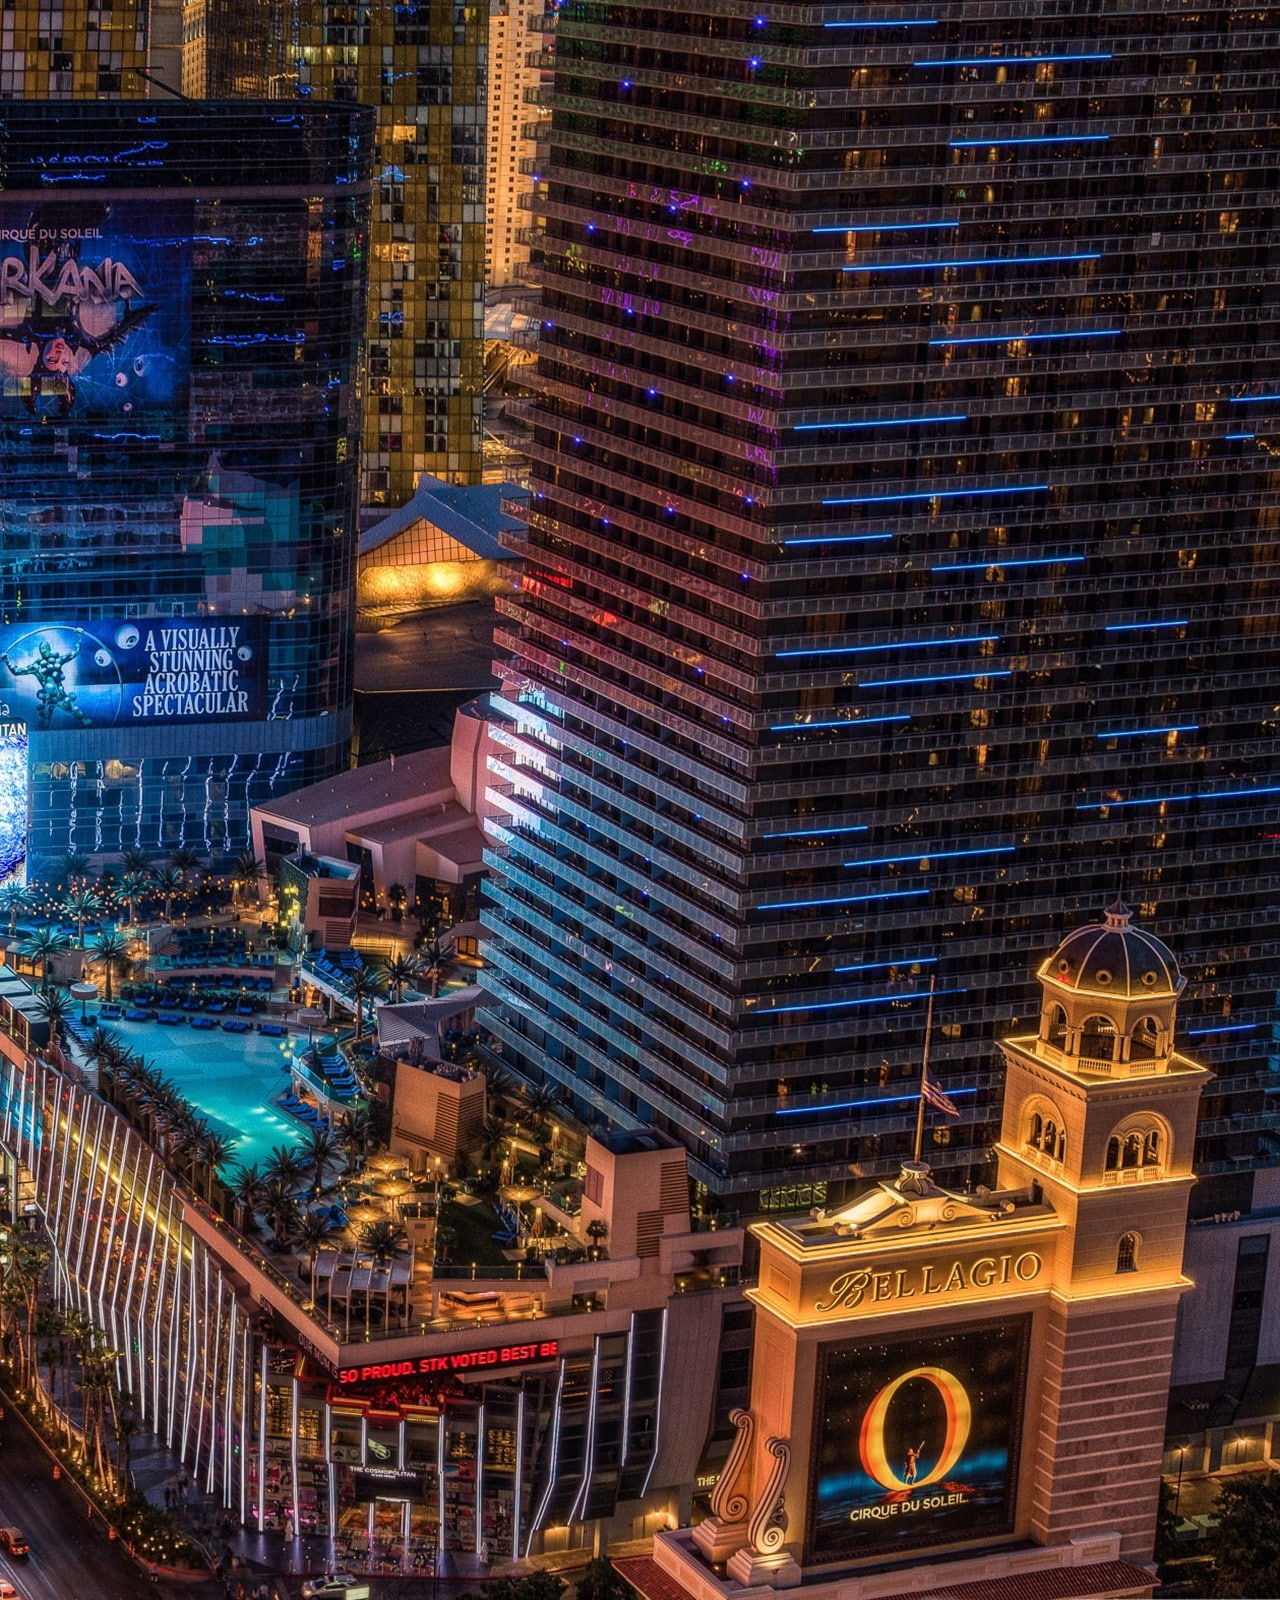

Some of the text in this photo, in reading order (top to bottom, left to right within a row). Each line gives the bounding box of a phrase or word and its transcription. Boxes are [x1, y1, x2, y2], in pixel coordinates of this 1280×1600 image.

[39, 229, 58, 240] DU
[60, 228, 103, 240] SOLEIL
[144, 626, 240, 651] A VISUALLY
[149, 649, 234, 674] STUNNING
[144, 670, 239, 695] ACROBATIC
[132, 691, 249, 717] SPECTACULAR
[815, 1251, 1043, 1312] BELLAGIO
[340, 1368, 358, 1384] SO
[362, 1361, 417, 1380] PROUD.
[420, 1357, 449, 1373] STK
[450, 1350, 498, 1368] VOTED
[501, 1344, 538, 1361] BEST
[859, 1366, 972, 1492] O
[349, 1465, 417, 1479] THE COSMOPOLITAN
[696, 1475, 716, 1487] THE
[849, 1493, 967, 1521] CIRQUE DU SOLEIL
